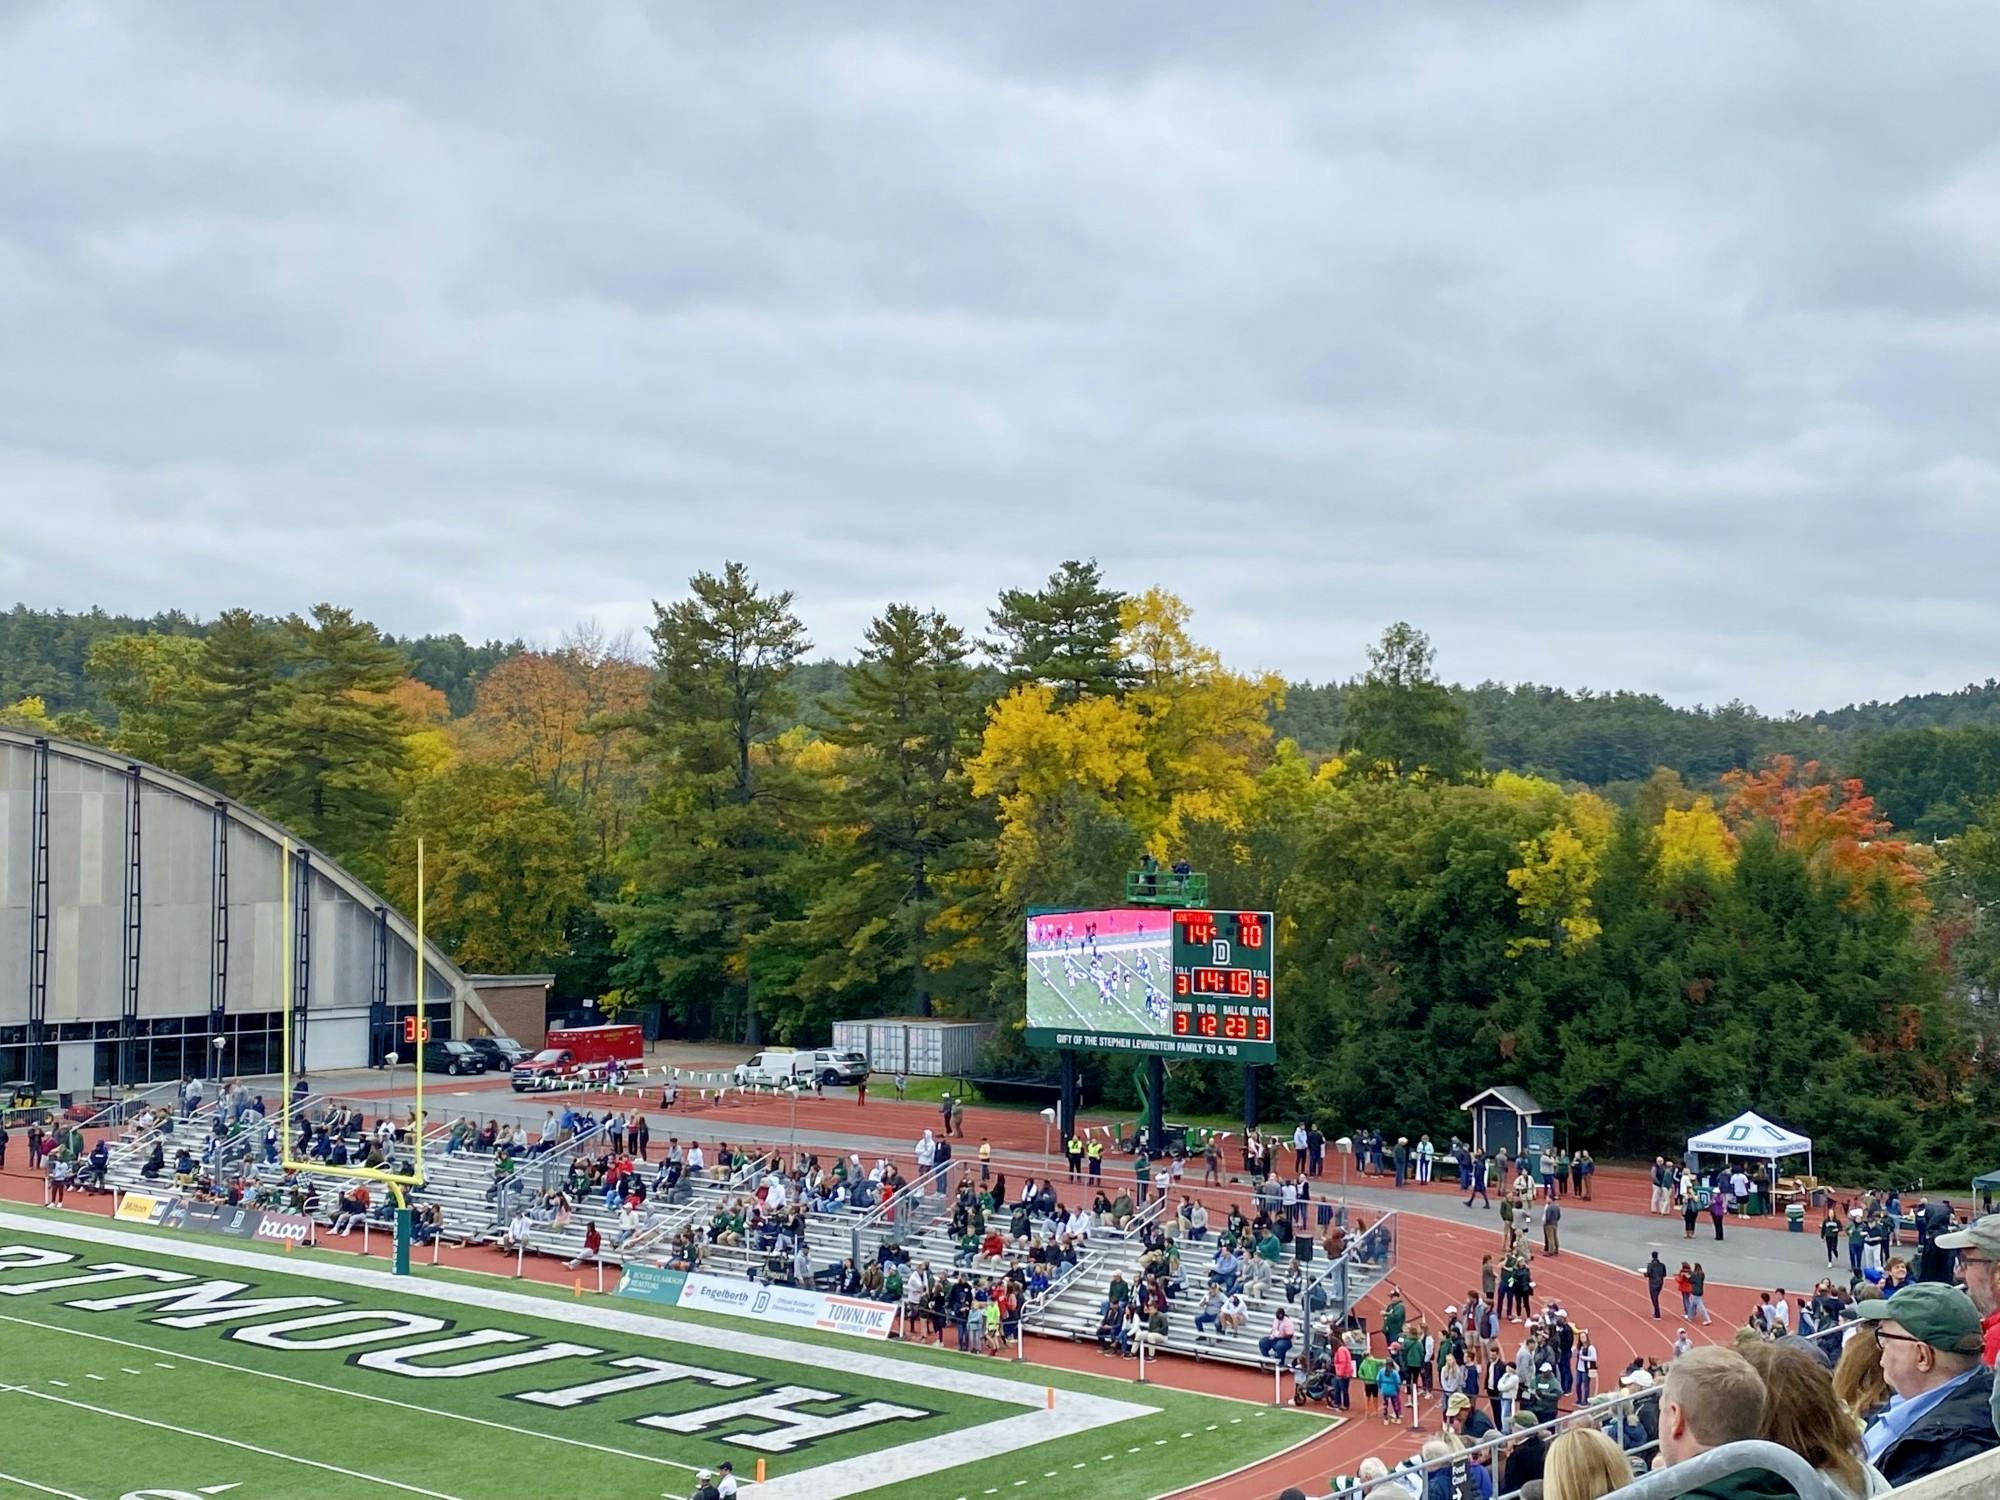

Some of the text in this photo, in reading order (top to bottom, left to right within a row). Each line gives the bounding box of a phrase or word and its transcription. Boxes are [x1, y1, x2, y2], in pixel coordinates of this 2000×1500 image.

[1190, 925, 1207, 944] 14
[1243, 926, 1262, 947] 10
[1178, 976, 1187, 994] 3
[1200, 971, 1249, 993] 14:16
[1257, 979, 1266, 998] 3
[1173, 1002, 1193, 1013] DOWN
[1197, 1003, 1217, 1014] TO GO
[1223, 1005, 1250, 1016] BALL ON
[1178, 1014, 1187, 1033] 3
[1201, 1016, 1217, 1036] 12
[1225, 1017, 1247, 1036] 23
[1257, 1019, 1266, 1037] 3
[1056, 1034, 1072, 1044] GIFT
[1073, 1035, 1083, 1045] OF
[1084, 1036, 1098, 1046] THE
[1099, 1037, 1131, 1048] STEPHEN
[1176, 1042, 1203, 1053] FAMILY
[701, 1286, 748, 1302] Engelberth
[828, 1304, 886, 1328] TOWNLINE
